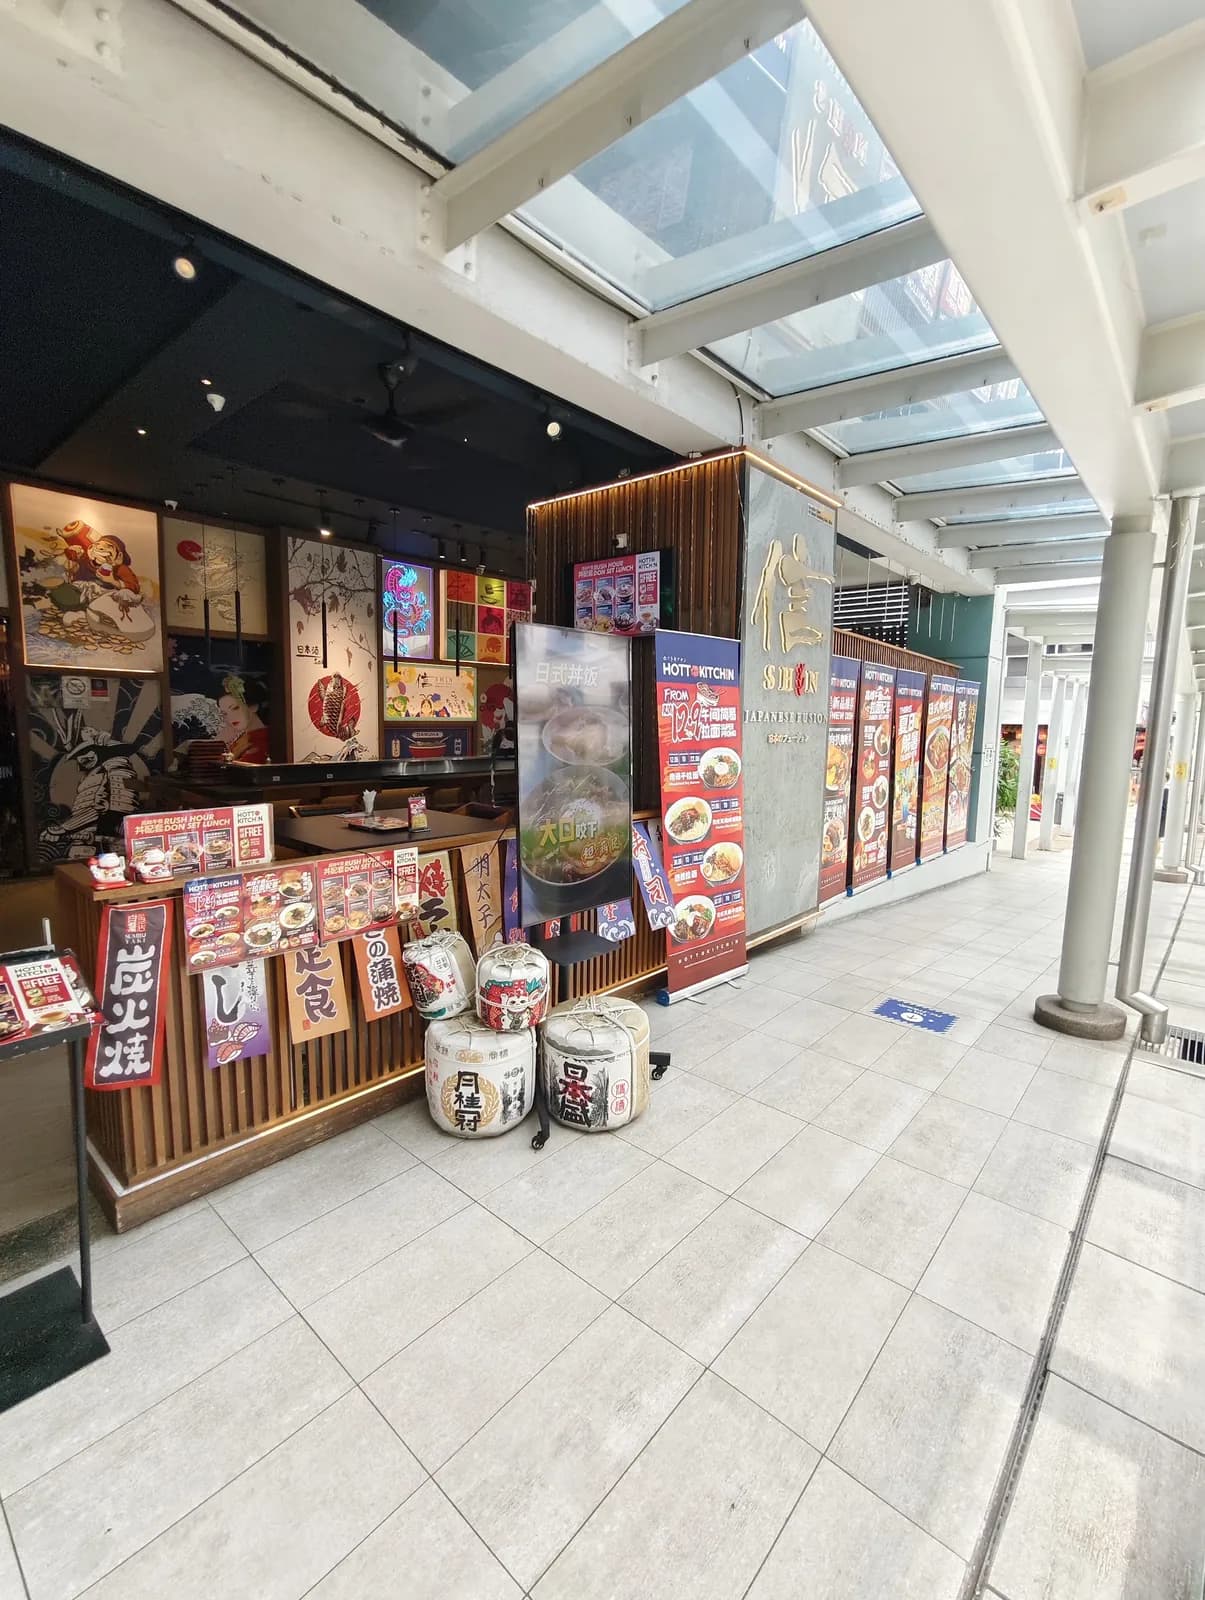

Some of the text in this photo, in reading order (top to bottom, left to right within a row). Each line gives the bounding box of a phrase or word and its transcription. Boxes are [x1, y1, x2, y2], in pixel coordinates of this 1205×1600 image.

[663, 688, 689, 701] FROM
[744, 709, 795, 724] JAPANESE
[164, 817, 187, 825] RUSH
[190, 813, 214, 822] HOUR
[164, 818, 230, 832] DON SET LUNCH
[244, 826, 263, 837] FREE
[345, 865, 360, 873] DON
[402, 866, 416, 875] FREE
[31, 974, 62, 988] FREE
[454, 1070, 482, 1132] 月桂冠
